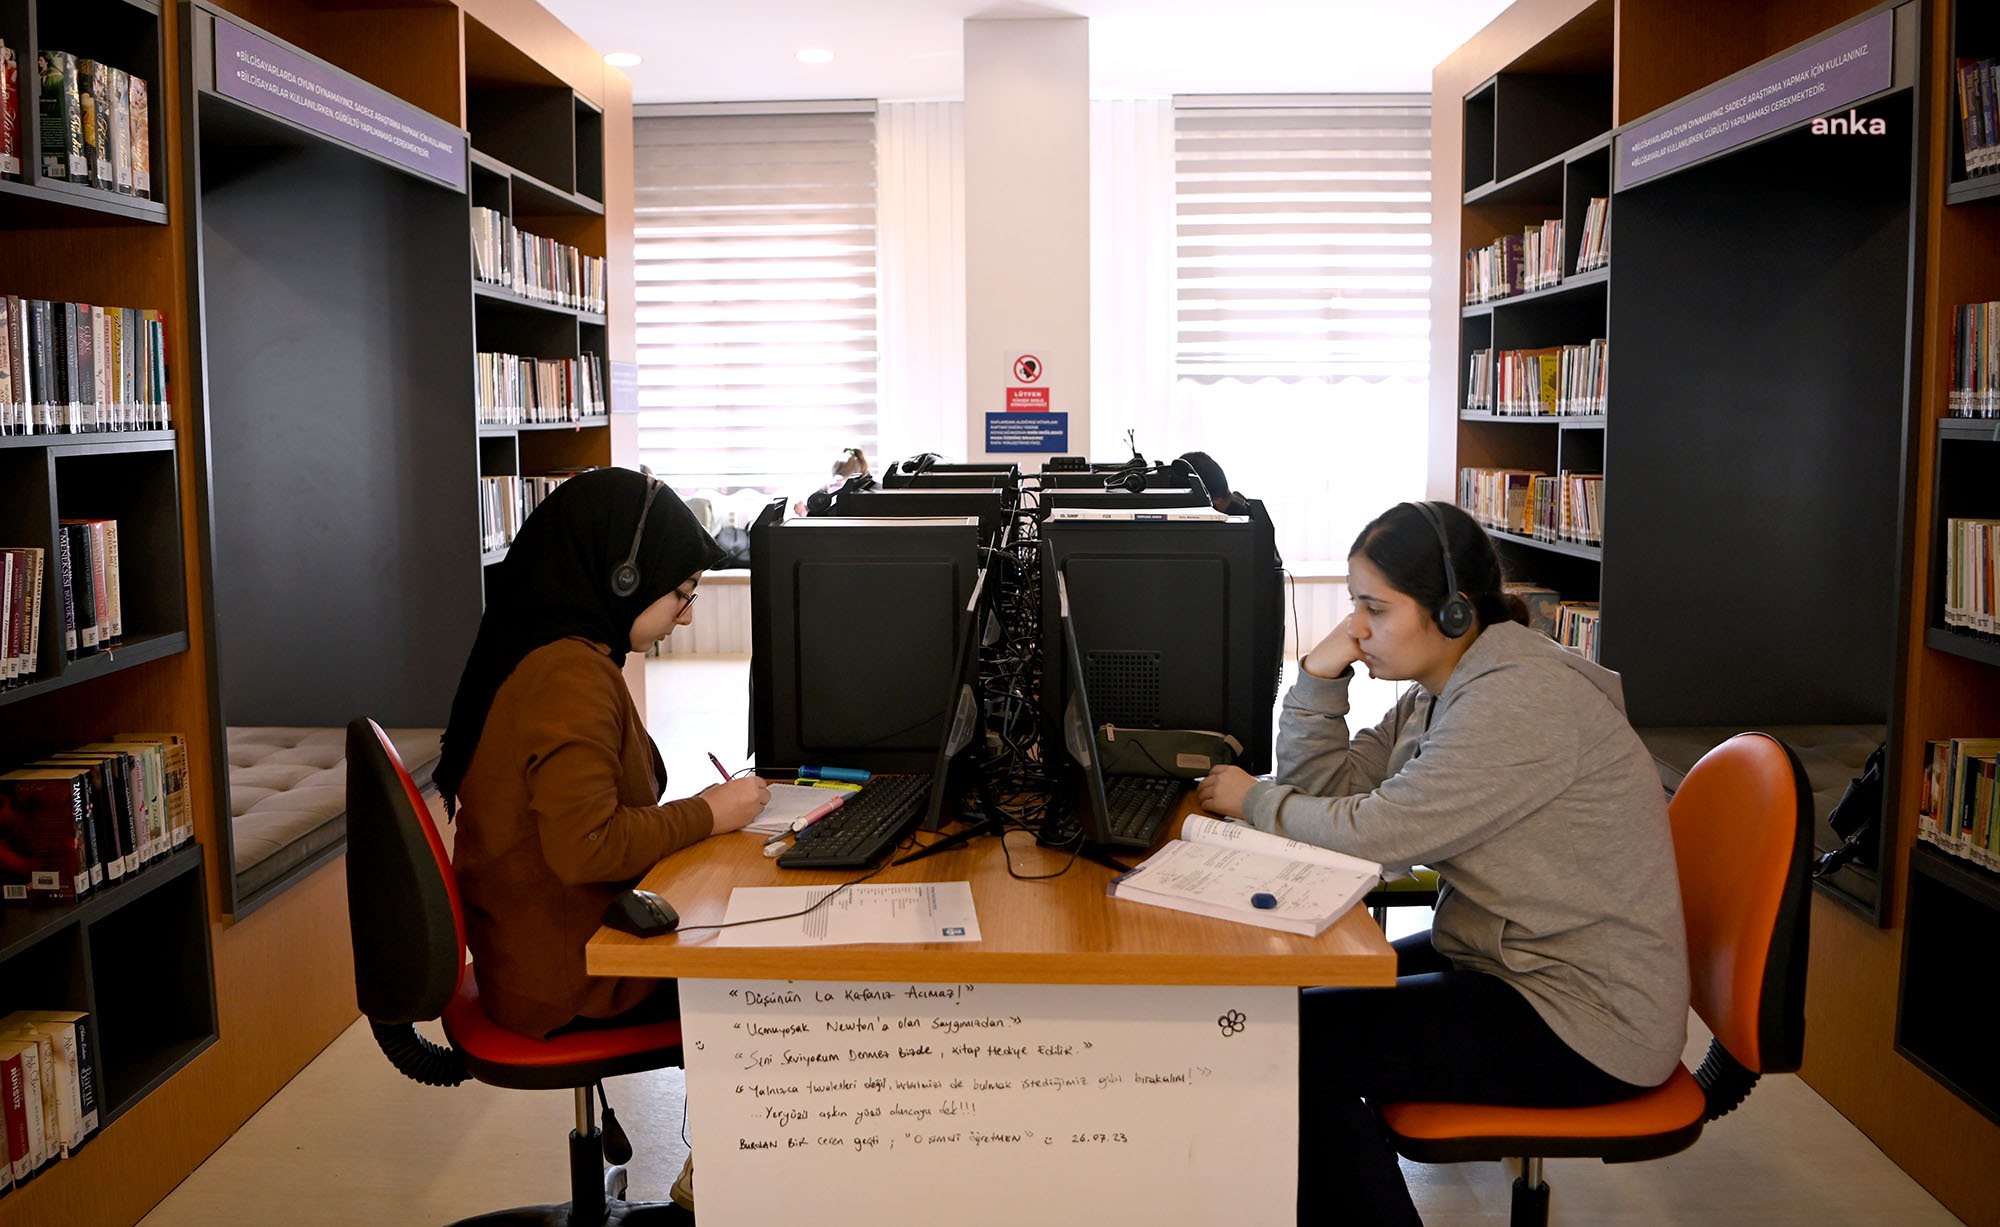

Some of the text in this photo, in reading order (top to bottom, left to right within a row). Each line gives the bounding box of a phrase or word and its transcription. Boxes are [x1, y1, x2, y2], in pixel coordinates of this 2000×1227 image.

[297, 77, 314, 92] OYUN
[354, 102, 374, 119] SADECE
[1673, 122, 1687, 136] OYUN
[1725, 96, 1747, 113] SADECE
[1747, 81, 1782, 104] ARAŞTIRMA
[1782, 70, 1810, 88] YAPMAK
[1704, 120, 1730, 138] GÜRÜLTÜ
[1730, 104, 1770, 127] YAPILMAMASI
[898, 1016, 921, 1028] olan
[950, 1078, 963, 1089] de
[1071, 1132, 1128, 1144] 26.07.23
